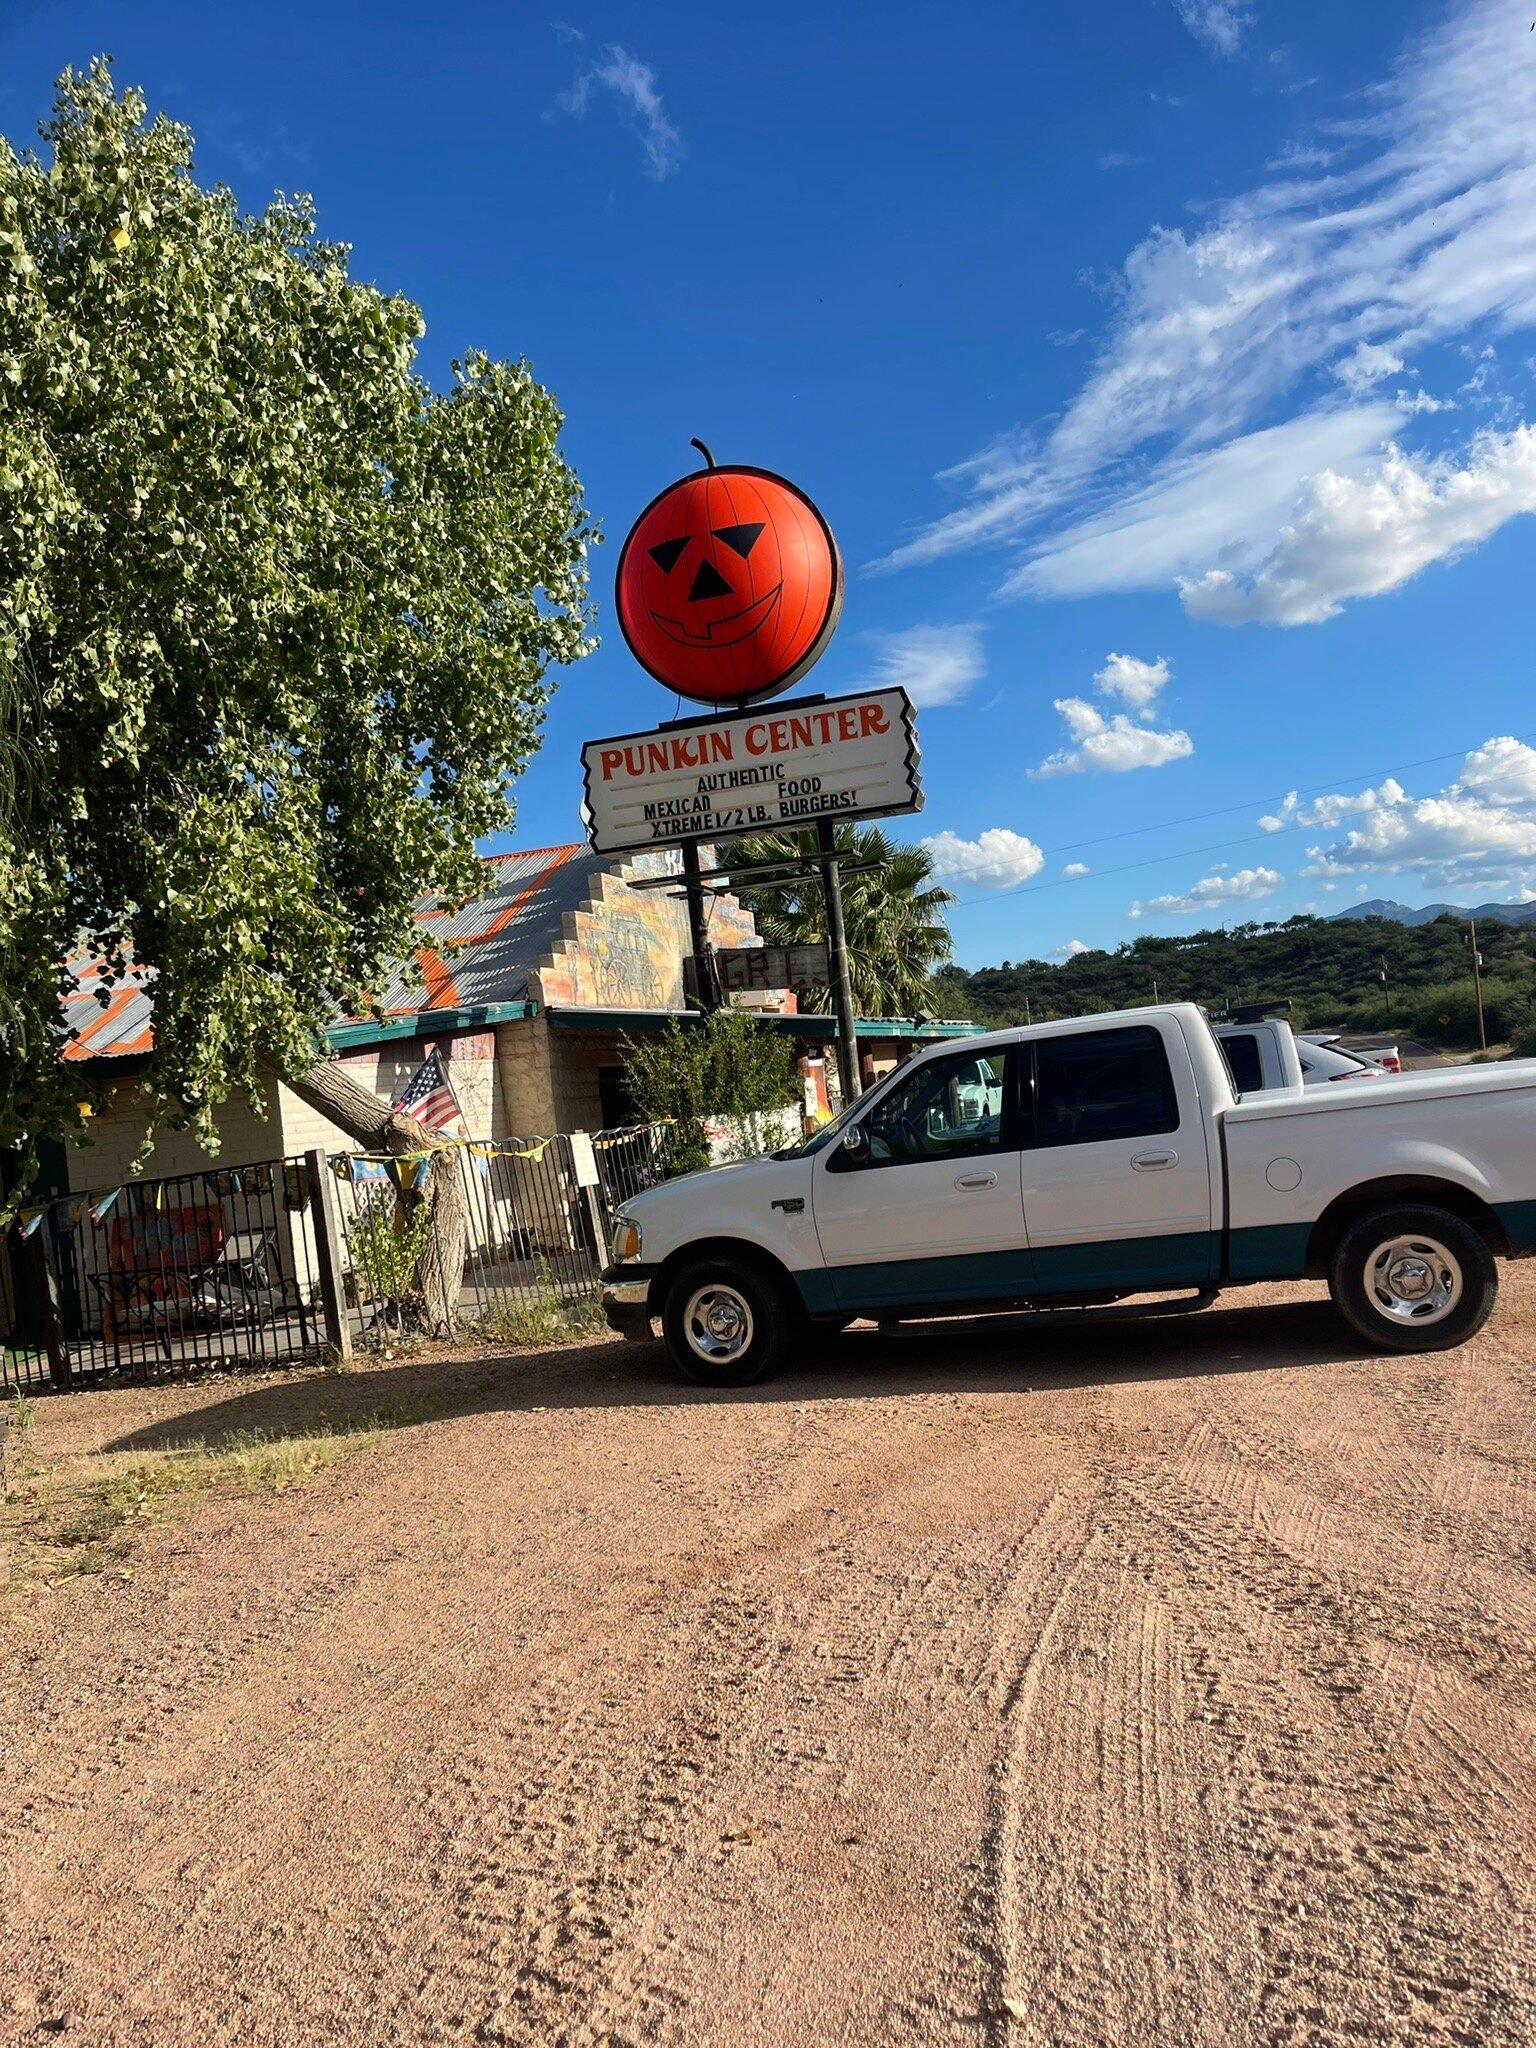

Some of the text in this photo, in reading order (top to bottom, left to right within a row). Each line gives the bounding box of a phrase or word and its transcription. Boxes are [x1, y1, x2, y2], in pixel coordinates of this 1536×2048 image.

[600, 704, 891, 781] PUNKIN CENTER
[778, 777, 822, 799] FOOD
[779, 789, 859, 818] BURGERS!
